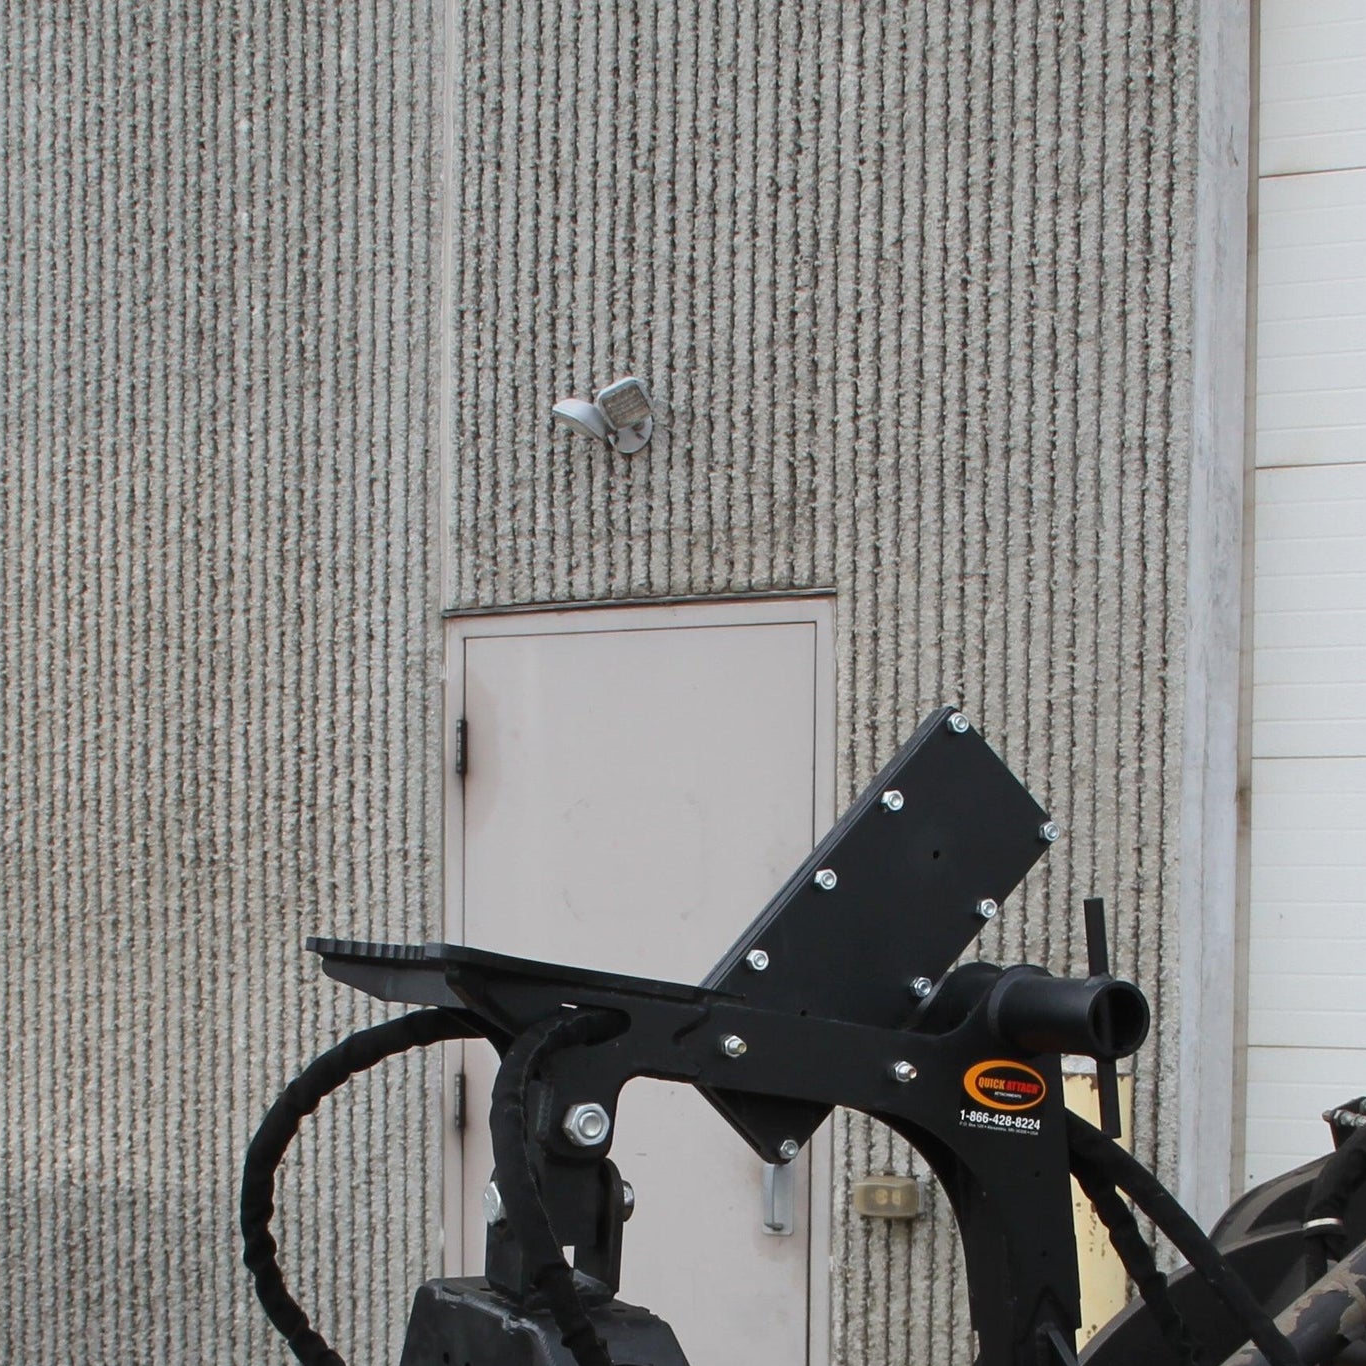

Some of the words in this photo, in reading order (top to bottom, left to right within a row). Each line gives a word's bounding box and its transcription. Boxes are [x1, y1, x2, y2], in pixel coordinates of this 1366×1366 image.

[978, 1077, 1005, 1090] QUICK
[1006, 1080, 1039, 1094] ATTACH
[960, 1109, 1041, 1131] 1-866-428-8224
